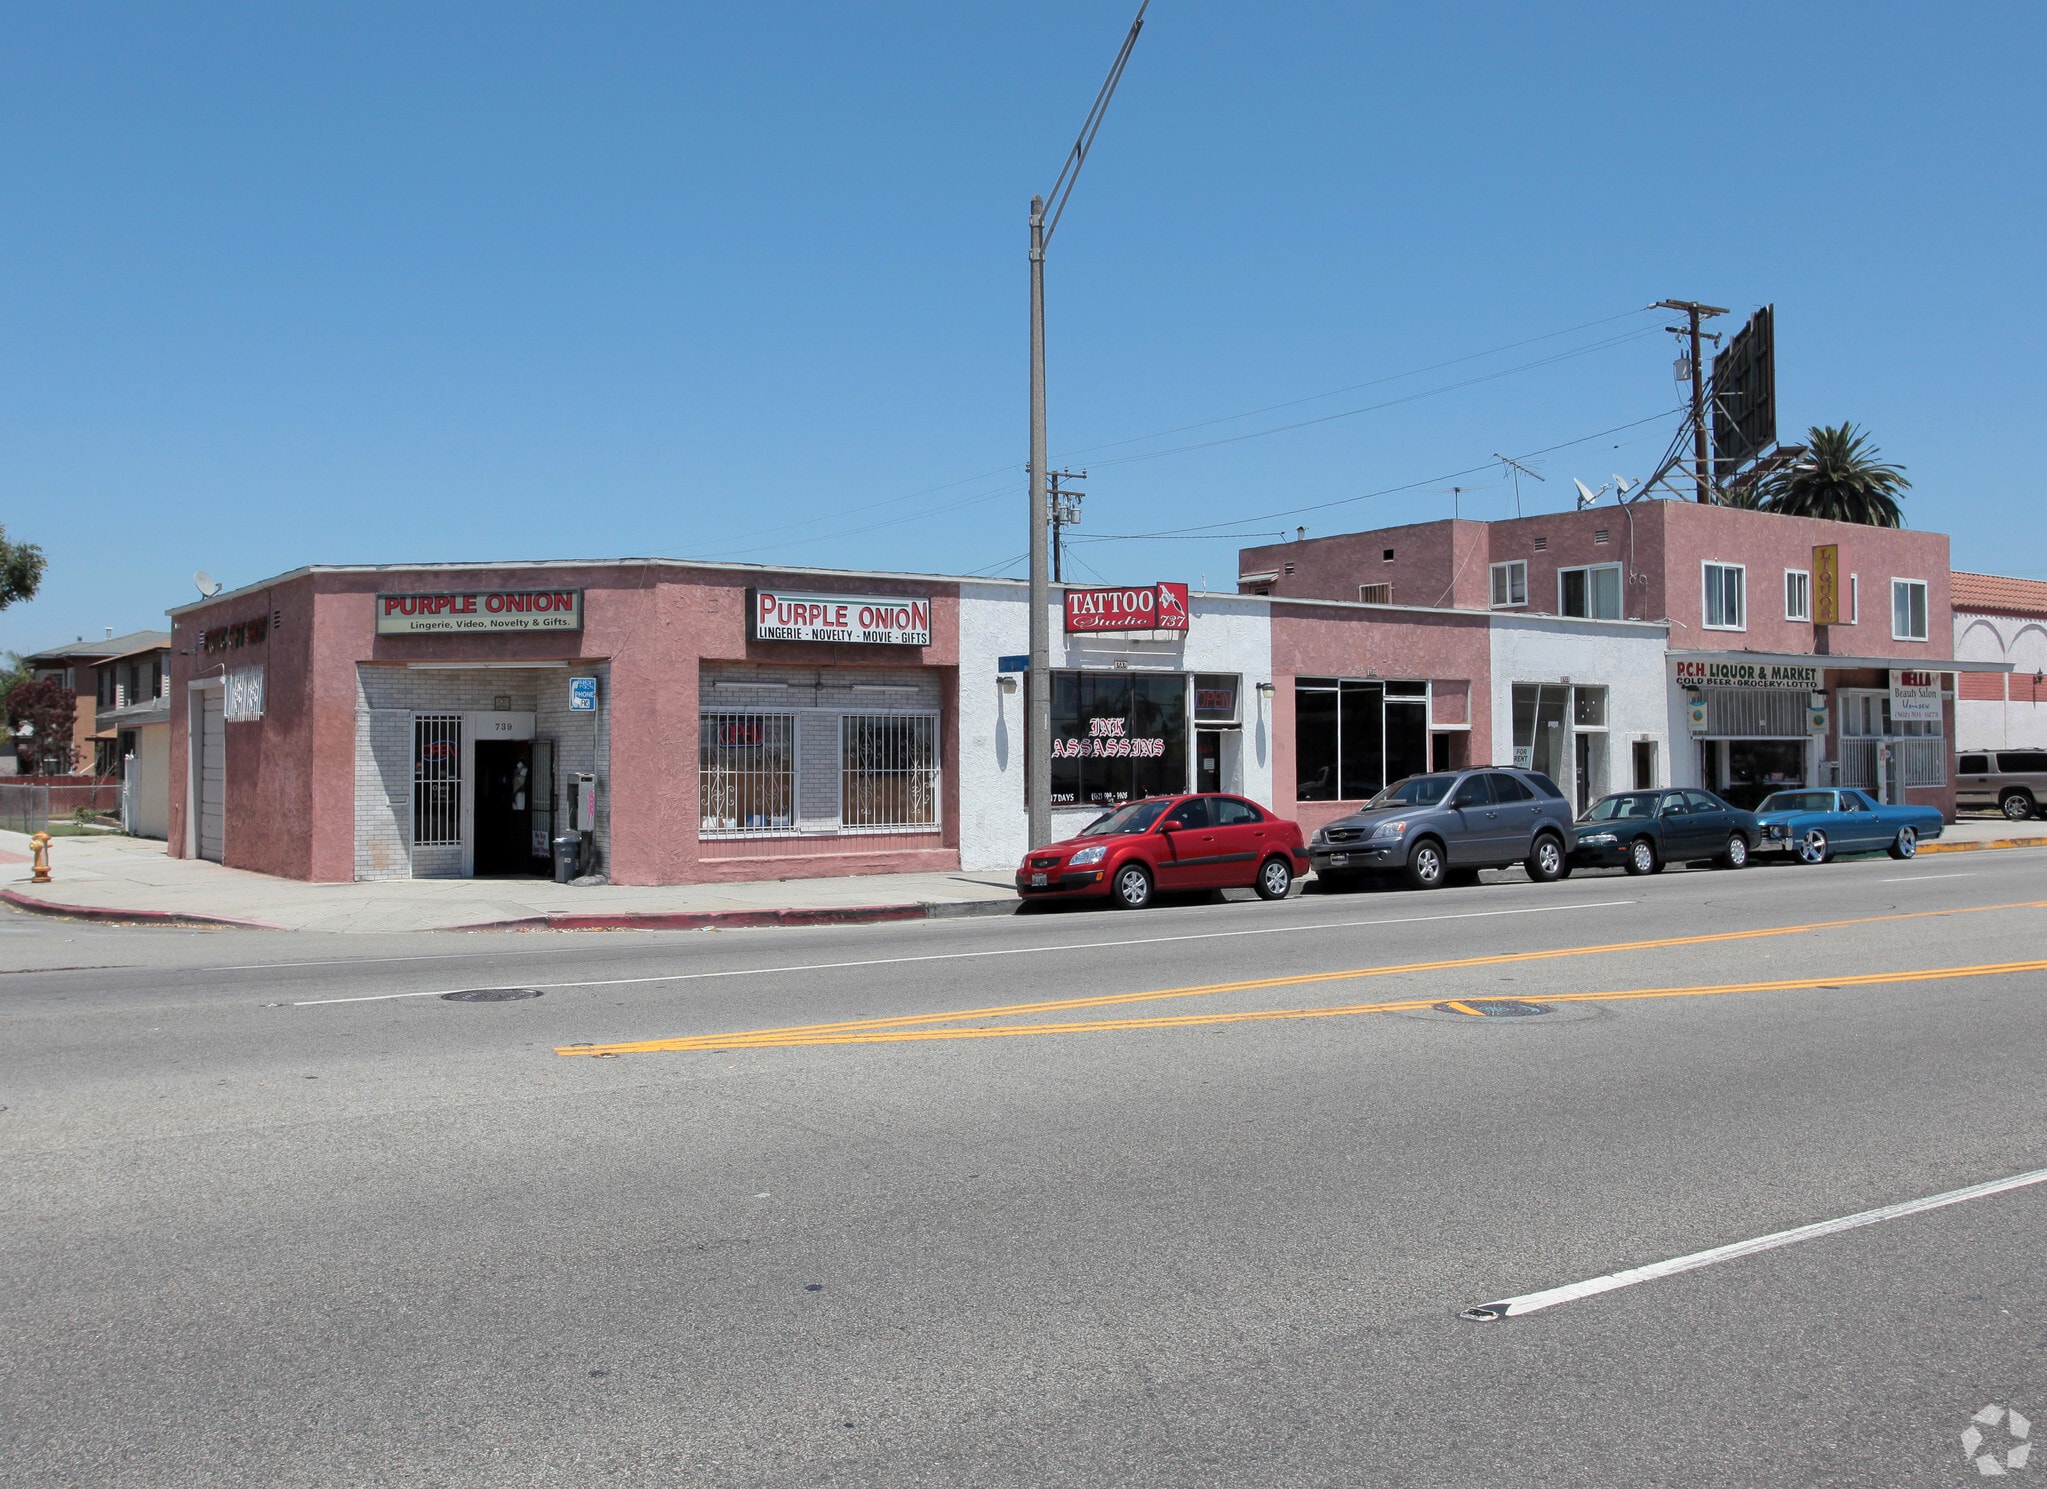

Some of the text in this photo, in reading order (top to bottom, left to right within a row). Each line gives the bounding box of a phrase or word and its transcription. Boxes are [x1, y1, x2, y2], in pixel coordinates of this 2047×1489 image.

[1819, 548, 1833, 618] LIQUOR
[384, 592, 573, 616] PURPLE ONION
[1069, 591, 1154, 614] TATTOO
[759, 594, 928, 631] PURPLE ONION
[1160, 614, 1186, 627] 737
[410, 617, 571, 630] Lingerie, Video, Novelty & Gifts.
[1073, 615, 1147, 629] Studio
[759, 626, 927, 644] LINGERIE NOVELTY MOVIE GIFTS
[1677, 661, 1816, 681] P.C.H. LIQUOR & MARKET
[1676, 677, 1704, 685] COLD
[1706, 678, 1732, 686] BEER
[1737, 679, 1783, 688] GROCERY
[1198, 691, 1230, 707] OPEN
[1895, 687, 1937, 699] Beauty Salon
[495, 722, 512, 731] 739
[1088, 717, 1126, 737] INK
[1051, 738, 1166, 759] ASSASSINS
[1058, 793, 1075, 802] DAYS
